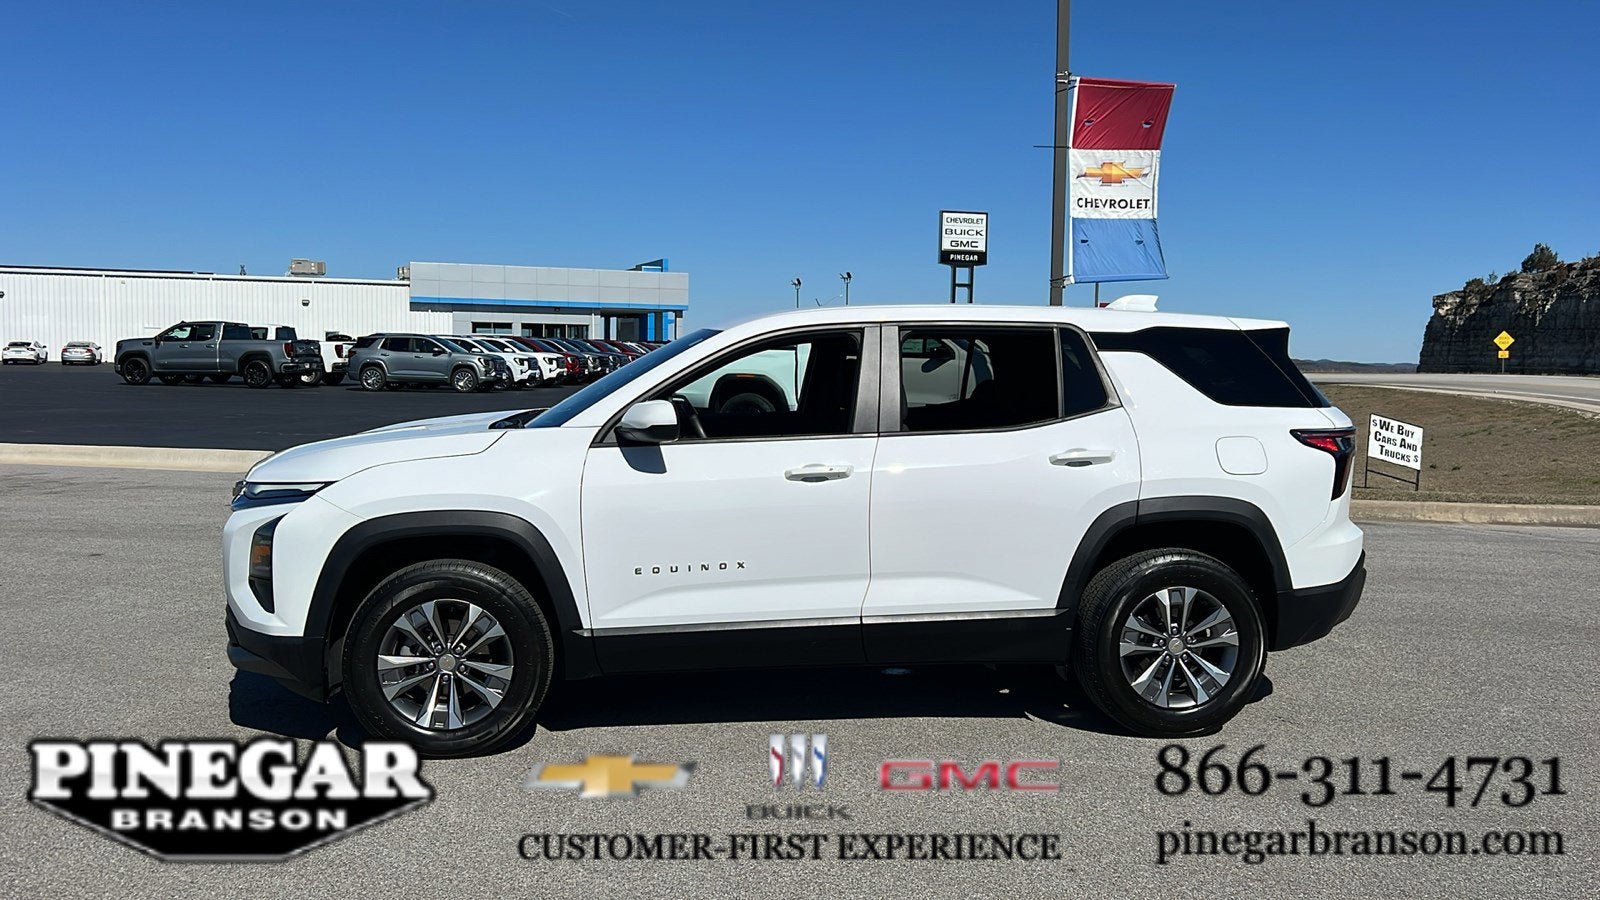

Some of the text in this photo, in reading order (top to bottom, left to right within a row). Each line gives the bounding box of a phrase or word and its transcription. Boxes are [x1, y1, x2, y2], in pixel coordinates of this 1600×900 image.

[1076, 197, 1150, 210] CHEVROLET
[945, 216, 984, 225] CHEVROLET
[944, 228, 984, 237] BUICK
[950, 240, 979, 248] GMC
[949, 253, 978, 261] PINEGAR
[1374, 430, 1418, 452] CARS AND
[1379, 444, 1411, 463] TRUCKS
[634, 561, 745, 575] EQUINOX
